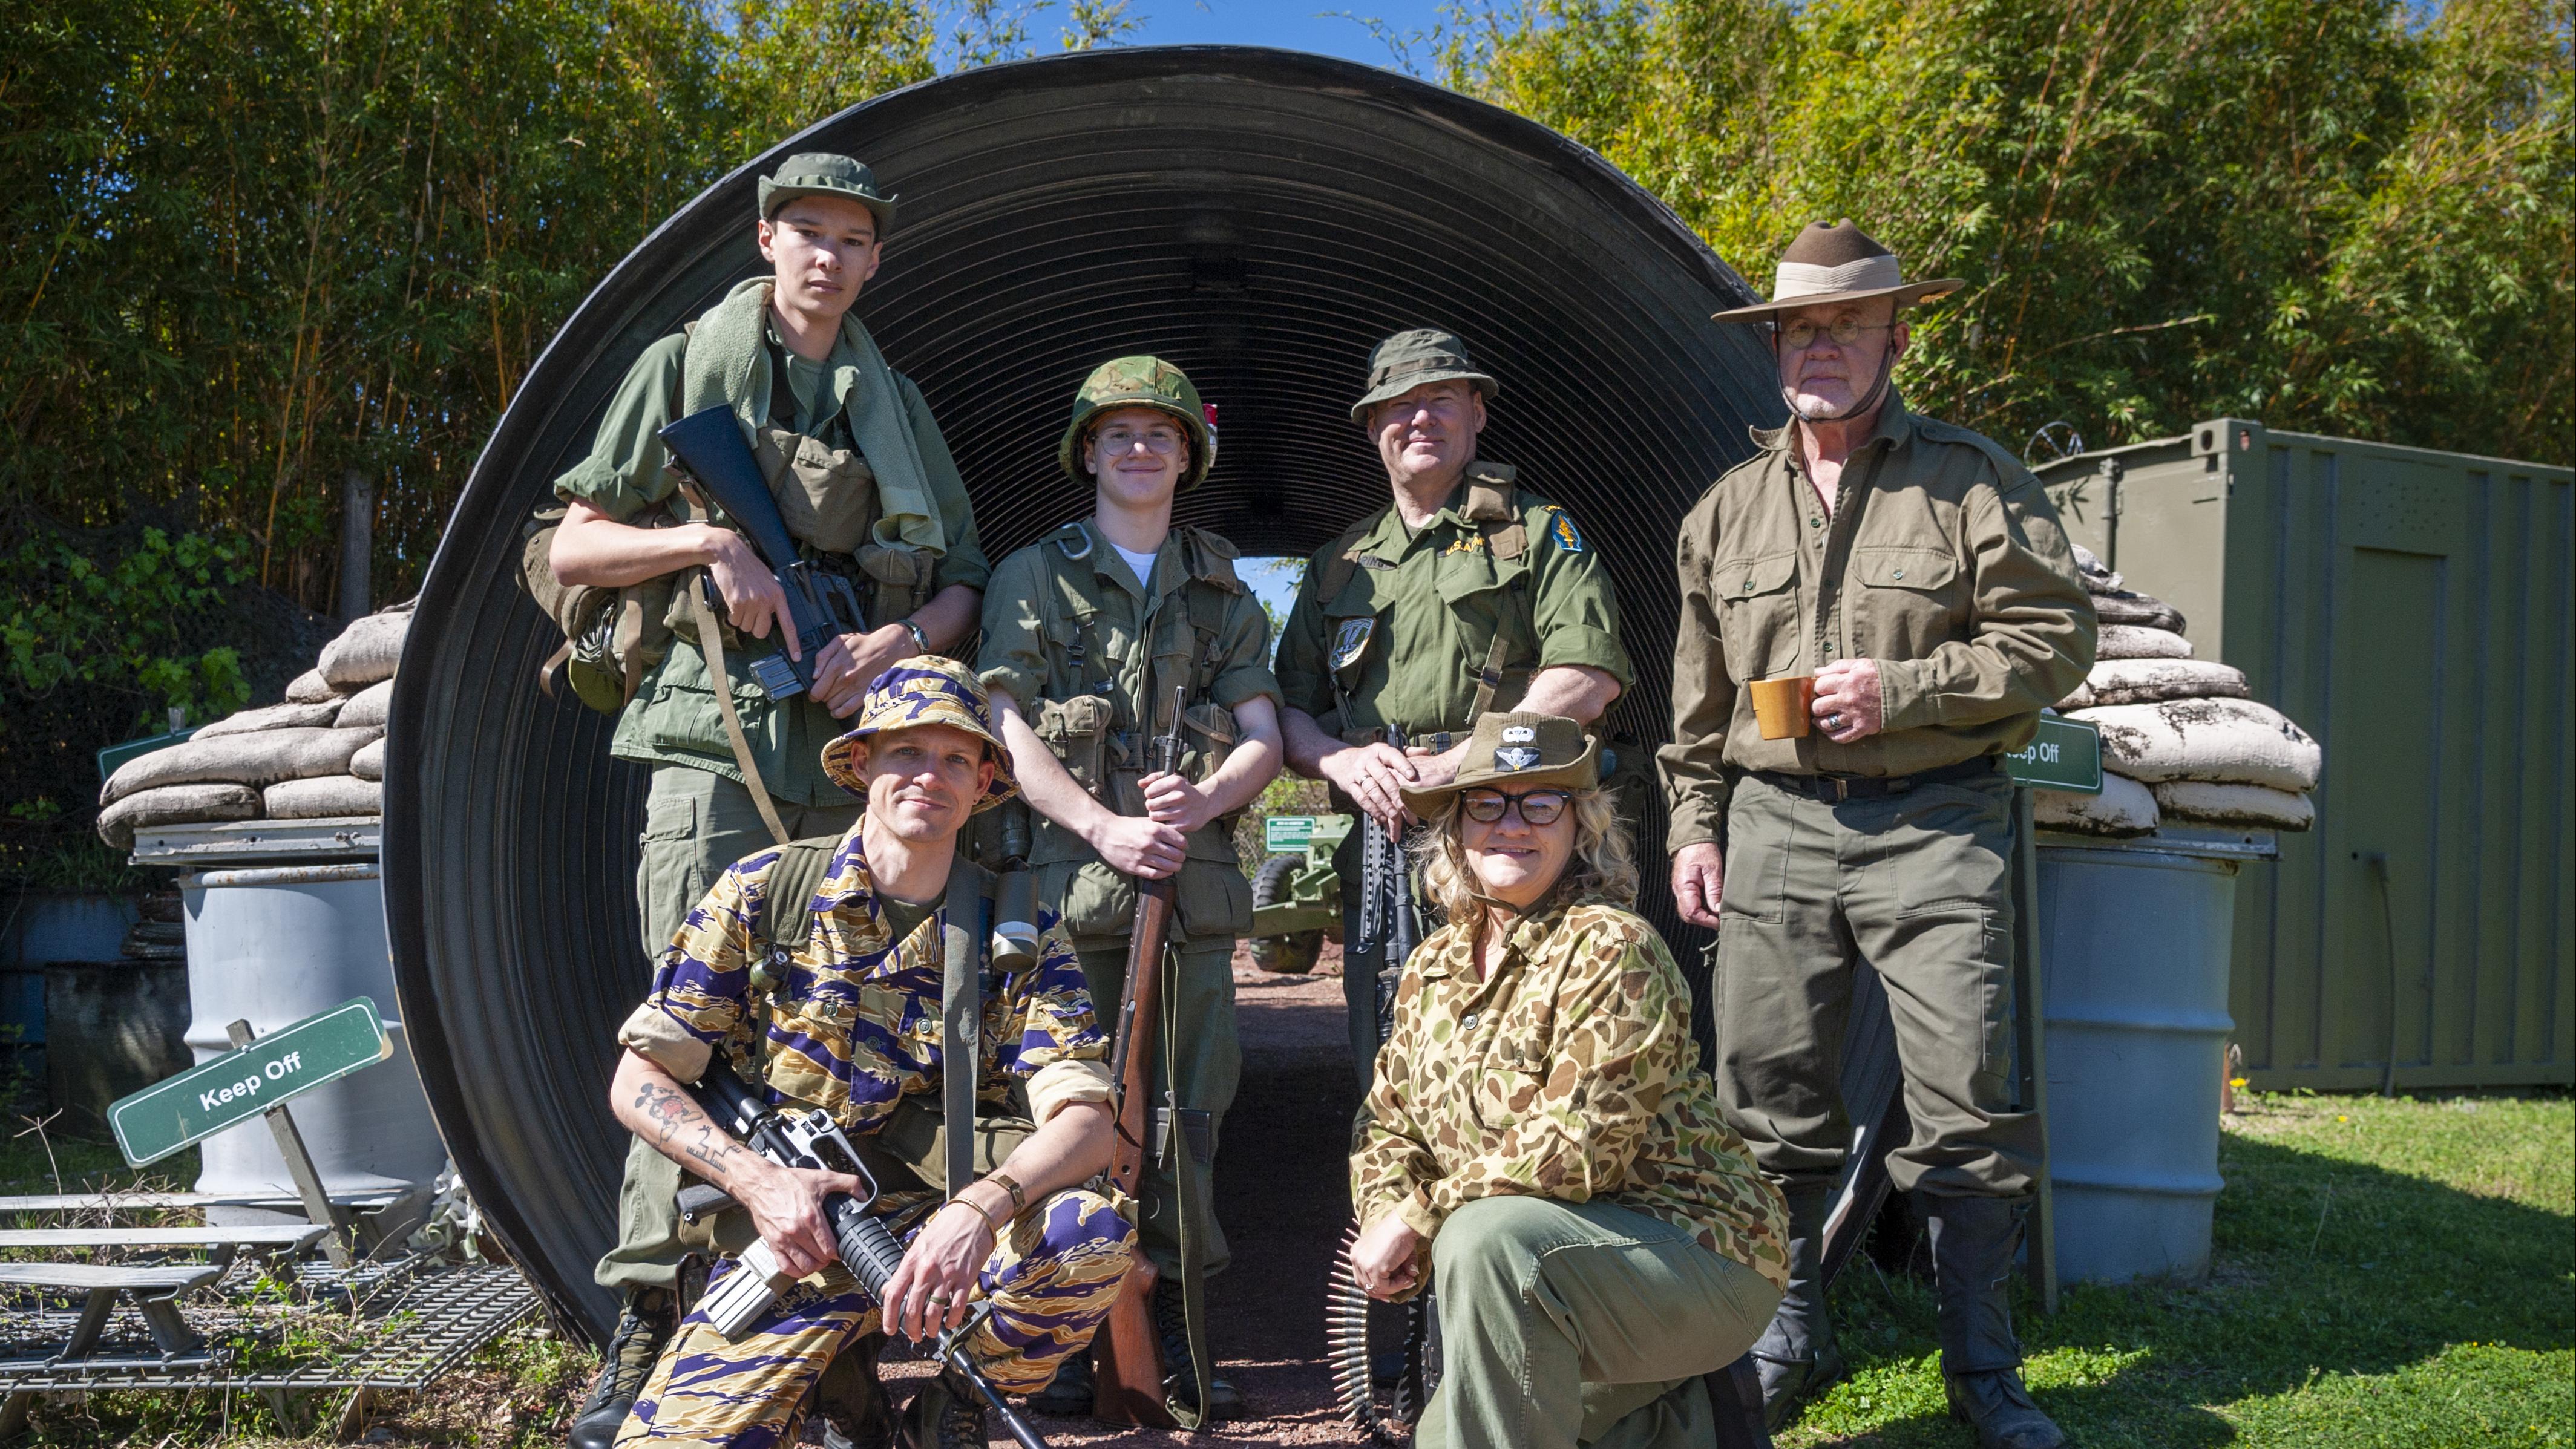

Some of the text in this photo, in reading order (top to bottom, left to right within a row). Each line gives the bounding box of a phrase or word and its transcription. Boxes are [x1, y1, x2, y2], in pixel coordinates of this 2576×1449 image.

[2039, 742, 2060, 763] Off
[198, 1051, 302, 1112] Keep Off
